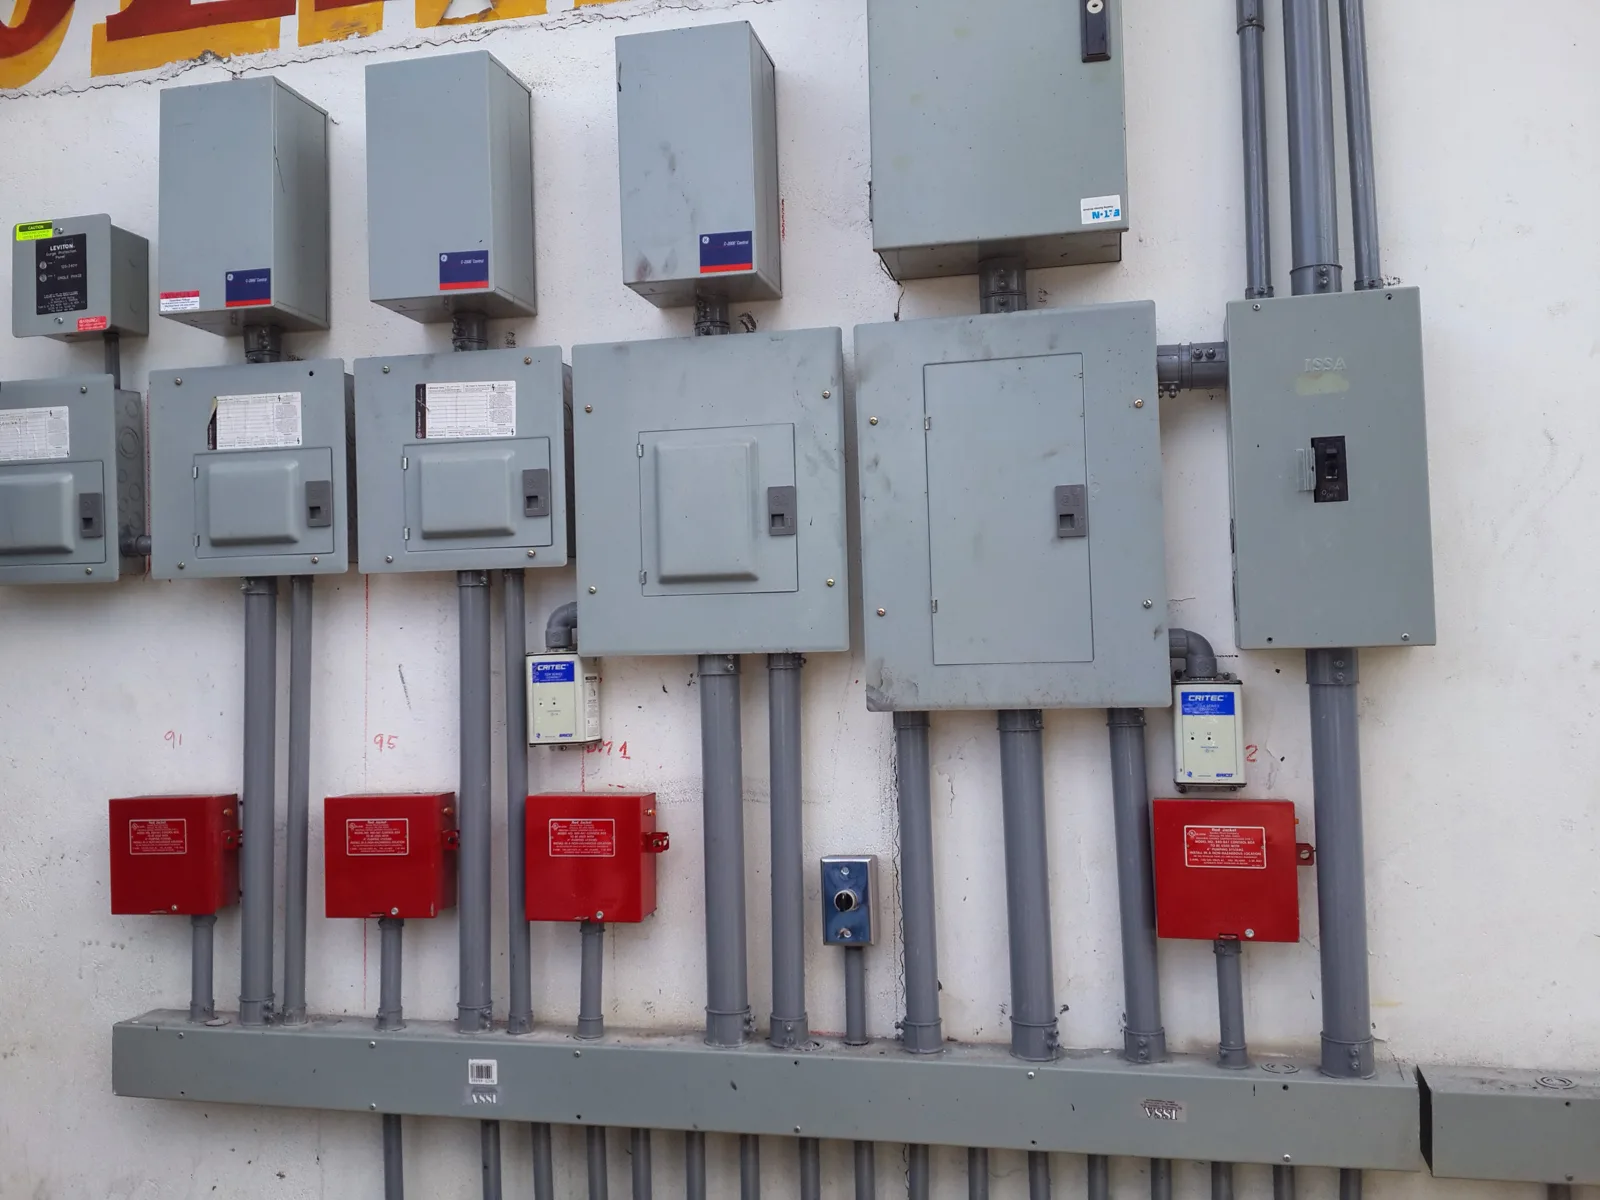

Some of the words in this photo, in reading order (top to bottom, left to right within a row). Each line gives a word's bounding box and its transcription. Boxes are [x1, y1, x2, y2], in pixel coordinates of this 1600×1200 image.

[1304, 357, 1347, 372] ISSA
[164, 730, 183, 749] 91
[373, 733, 399, 752] 95
[1245, 744, 1258, 763] 2
[1144, 1107, 1178, 1120] ISSA
